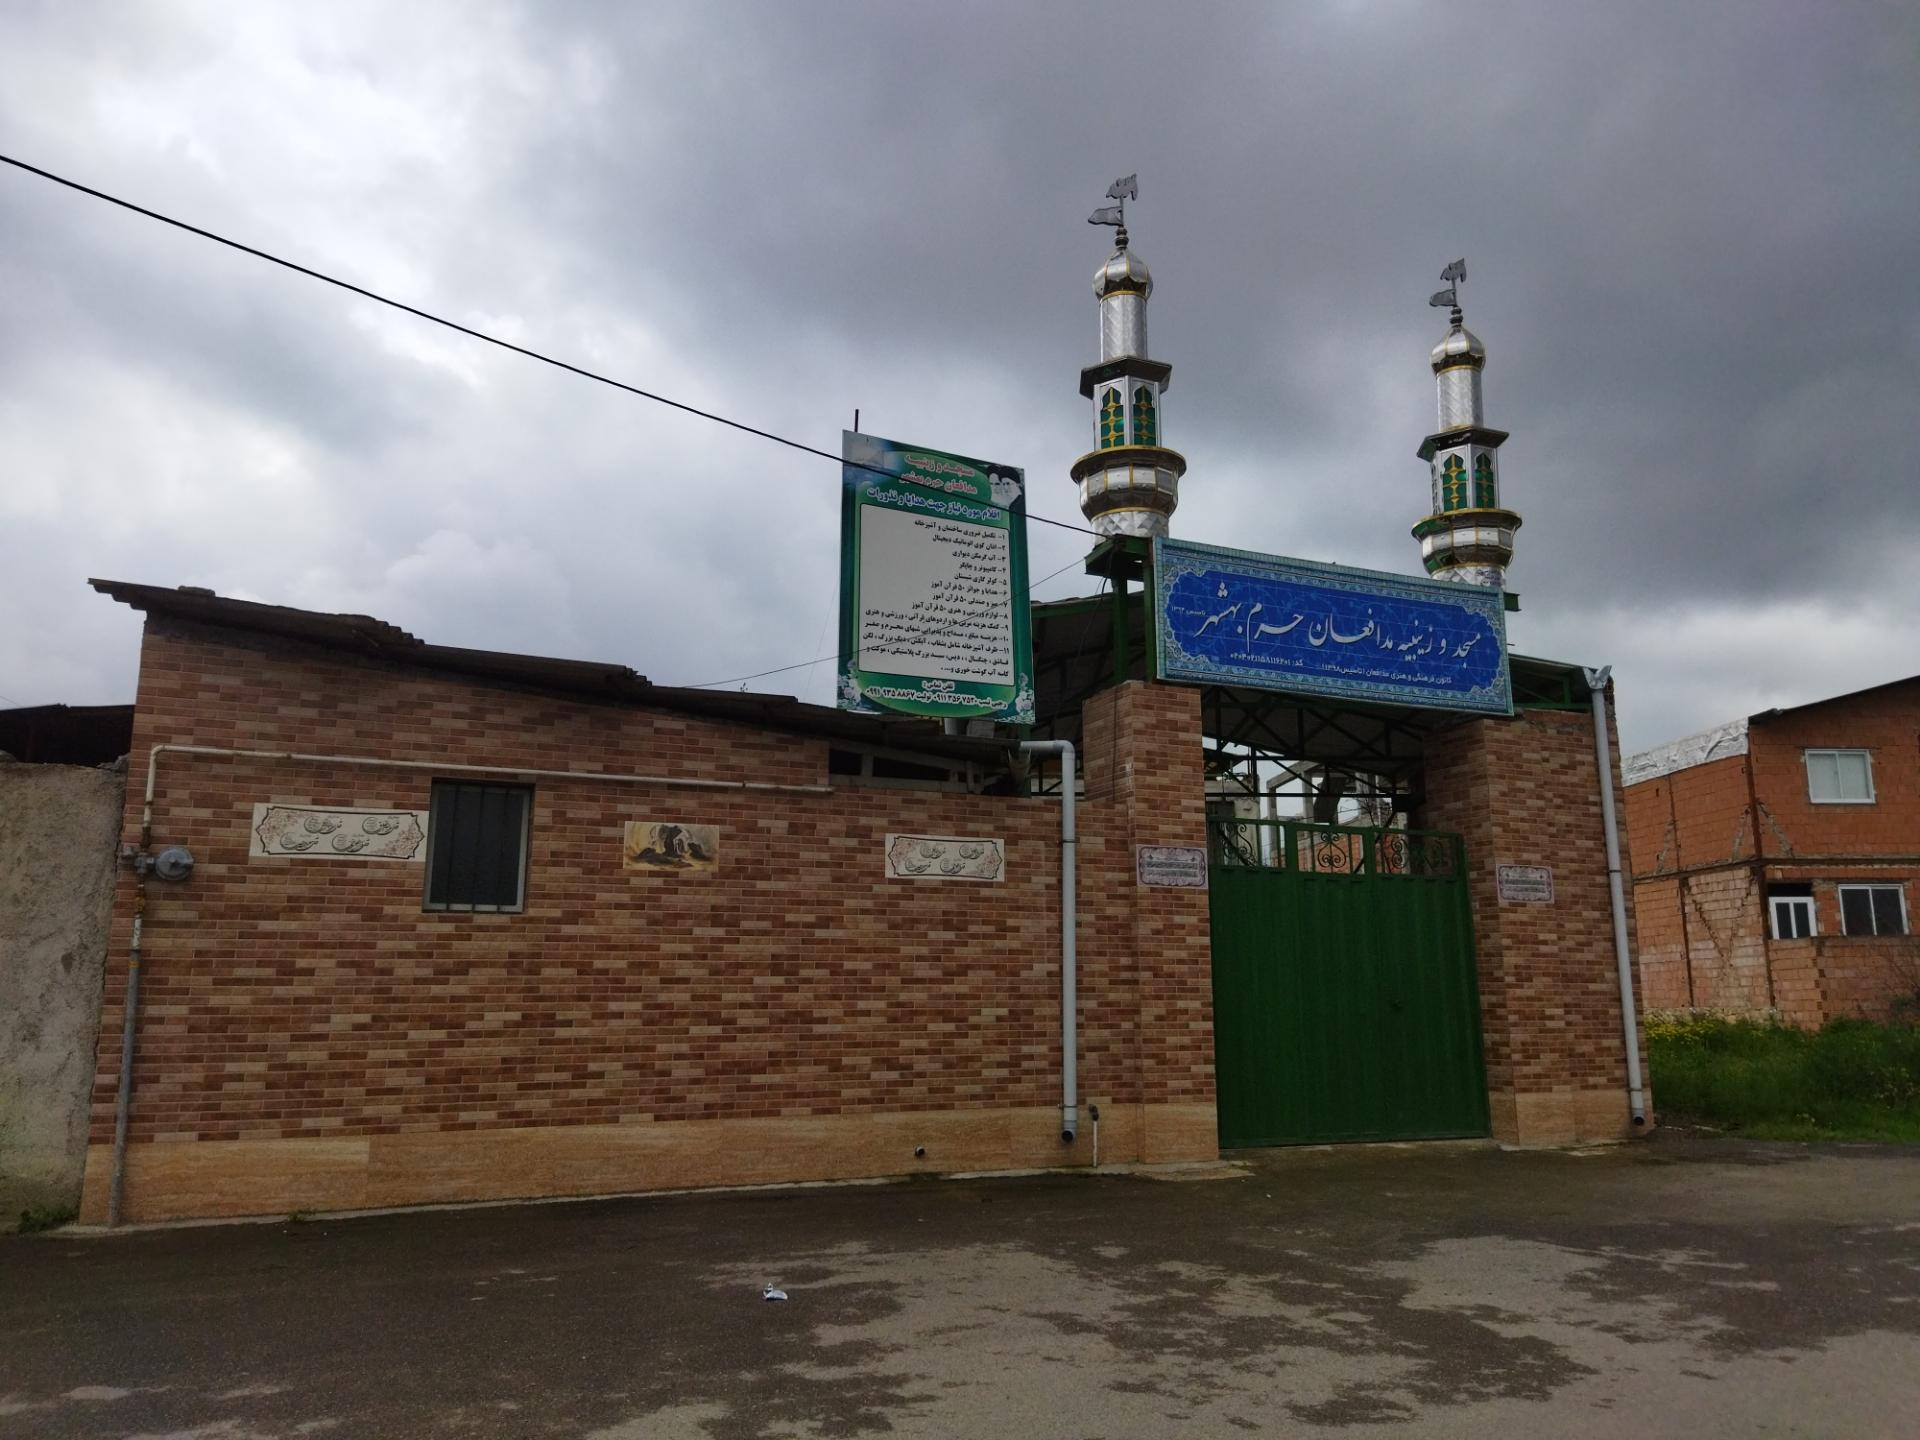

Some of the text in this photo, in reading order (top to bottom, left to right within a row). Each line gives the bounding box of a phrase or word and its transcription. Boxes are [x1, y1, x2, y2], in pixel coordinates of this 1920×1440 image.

[866, 486, 1000, 520] اقلام مورد نیاز جهت هدایا و نذورات
[944, 478, 978, 494] مدافعان
[1193, 580, 1481, 670] مسجد و زینبیه مدافعان حرم بهشهر
